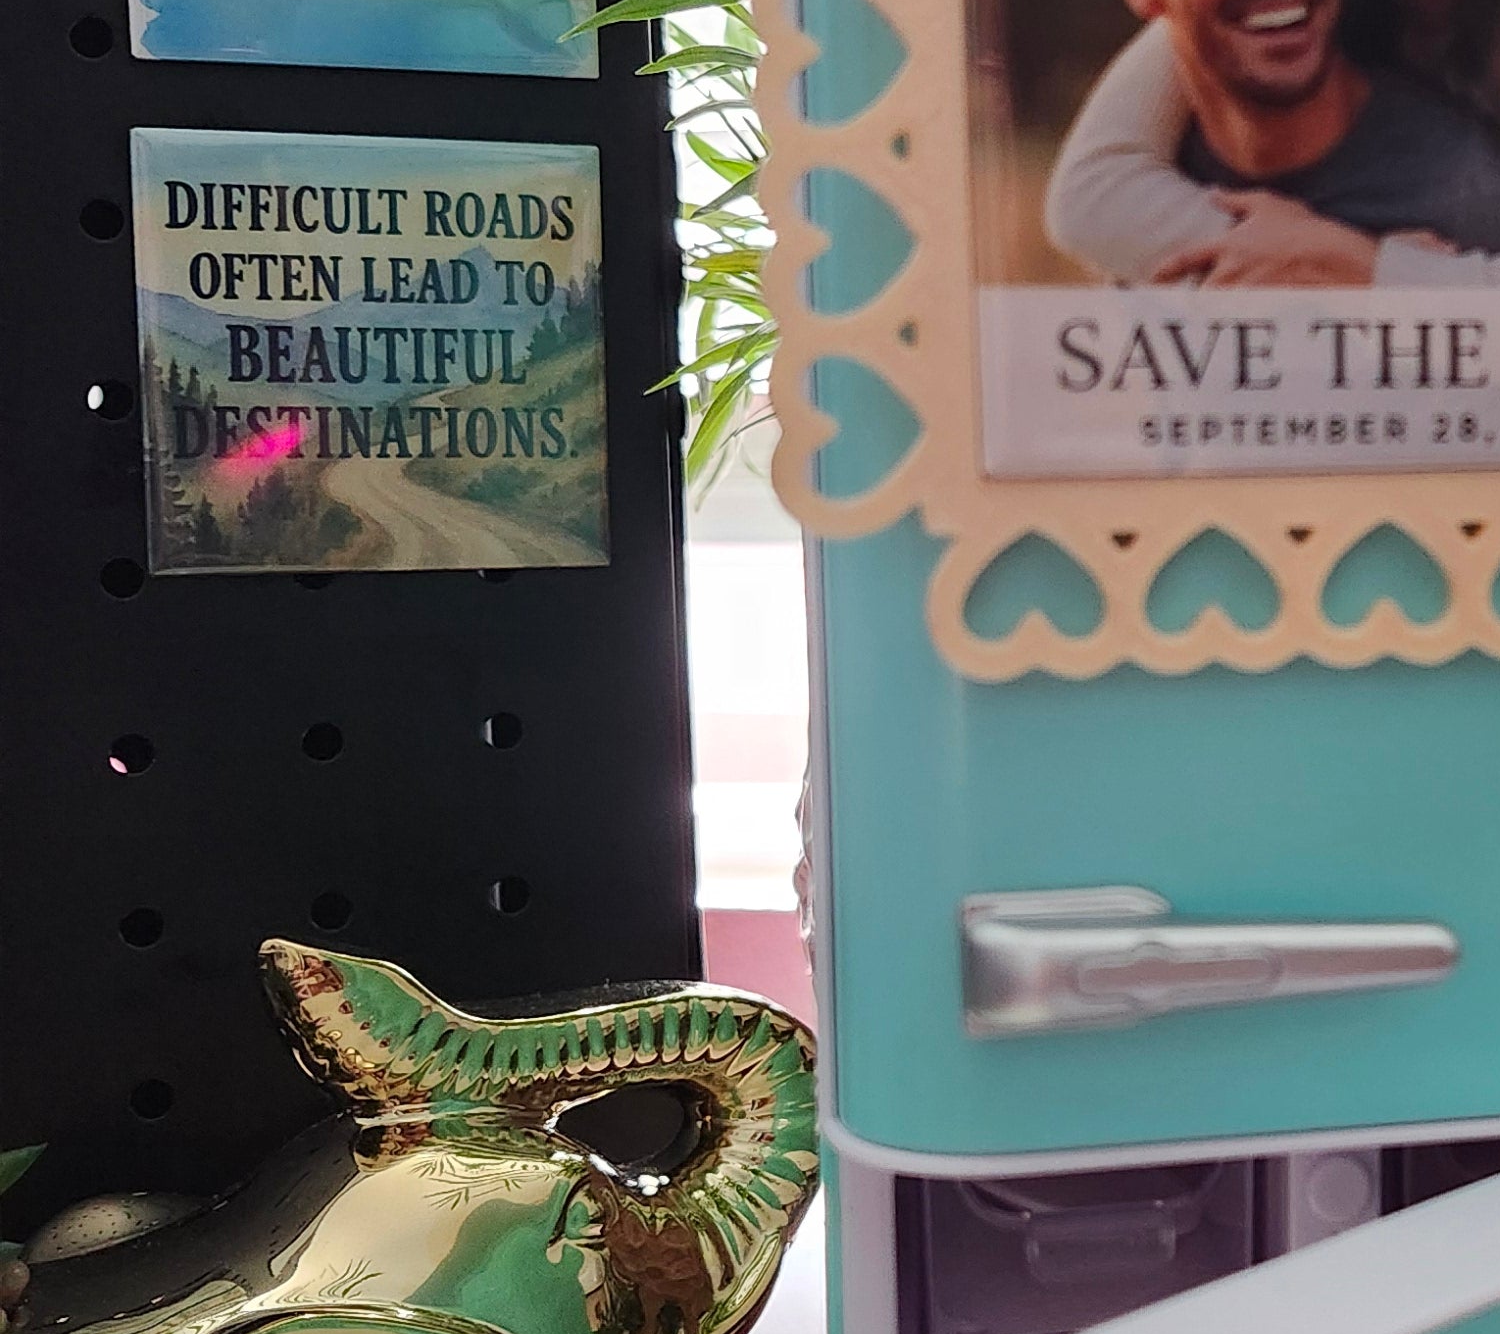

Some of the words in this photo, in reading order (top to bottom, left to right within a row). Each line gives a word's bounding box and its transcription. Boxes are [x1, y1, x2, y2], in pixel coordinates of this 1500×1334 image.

[164, 180, 408, 236] DIFFICULT
[423, 190, 576, 241] ROADS
[189, 251, 341, 303] OFTEN
[361, 256, 480, 305] LEAD
[494, 261, 555, 307] TO
[226, 324, 528, 387] BEAUTIFUL
[1057, 317, 1282, 394] SAVE
[1309, 318, 1488, 391] THE
[172, 405, 580, 460] DESTINATIONS.
[1140, 412, 1408, 448] SEPTEMBER
